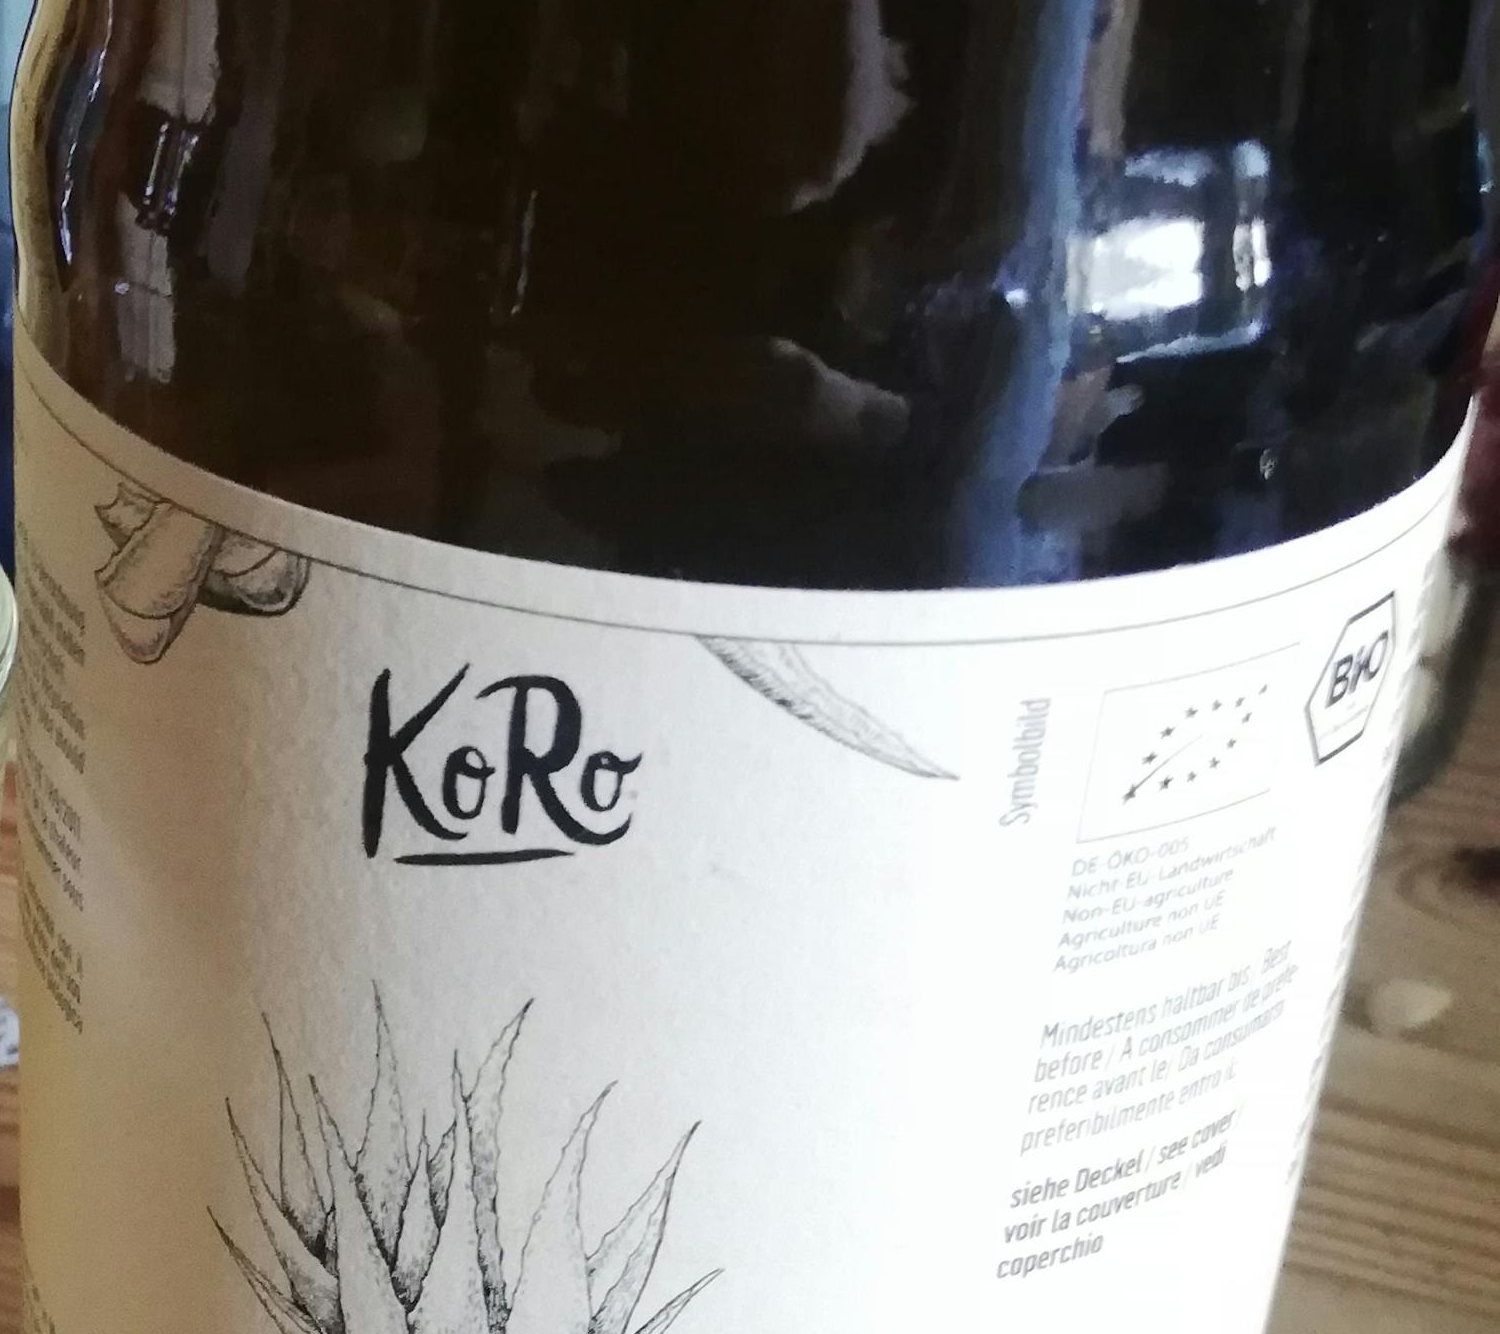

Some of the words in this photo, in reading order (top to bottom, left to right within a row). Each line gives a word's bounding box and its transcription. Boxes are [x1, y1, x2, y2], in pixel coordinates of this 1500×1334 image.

[362, 663, 643, 866] KoRo
[999, 697, 1052, 827] Symbolbild
[1051, 938, 1158, 974] Agricoltura
[1161, 925, 1195, 947] non
[1199, 913, 1221, 935] UE
[1057, 914, 1164, 951] Agriculture
[1167, 902, 1200, 924] non
[1203, 889, 1227, 912] UE
[1033, 1045, 1104, 1084] before
[1138, 999, 1239, 1058] consommer
[1040, 1003, 1158, 1050] Mindestens
[1160, 977, 1225, 1019] haltbar
[1019, 1087, 1176, 1158] preferibilmente
[1178, 1069, 1222, 1106] entro
[1027, 1081, 1088, 1116] rence
[1091, 1064, 1148, 1102] avant
[1177, 1043, 1199, 1073] Da
[1010, 1176, 1069, 1209] siehe
[1074, 1147, 1145, 1194] Deckel
[1156, 1135, 1189, 1165] see
[1190, 1108, 1237, 1150] cover
[1004, 1212, 1048, 1244] voir
[1050, 1207, 1072, 1234] la
[1075, 1169, 1182, 1227] couverture
[996, 1231, 1104, 1279] coperchio
